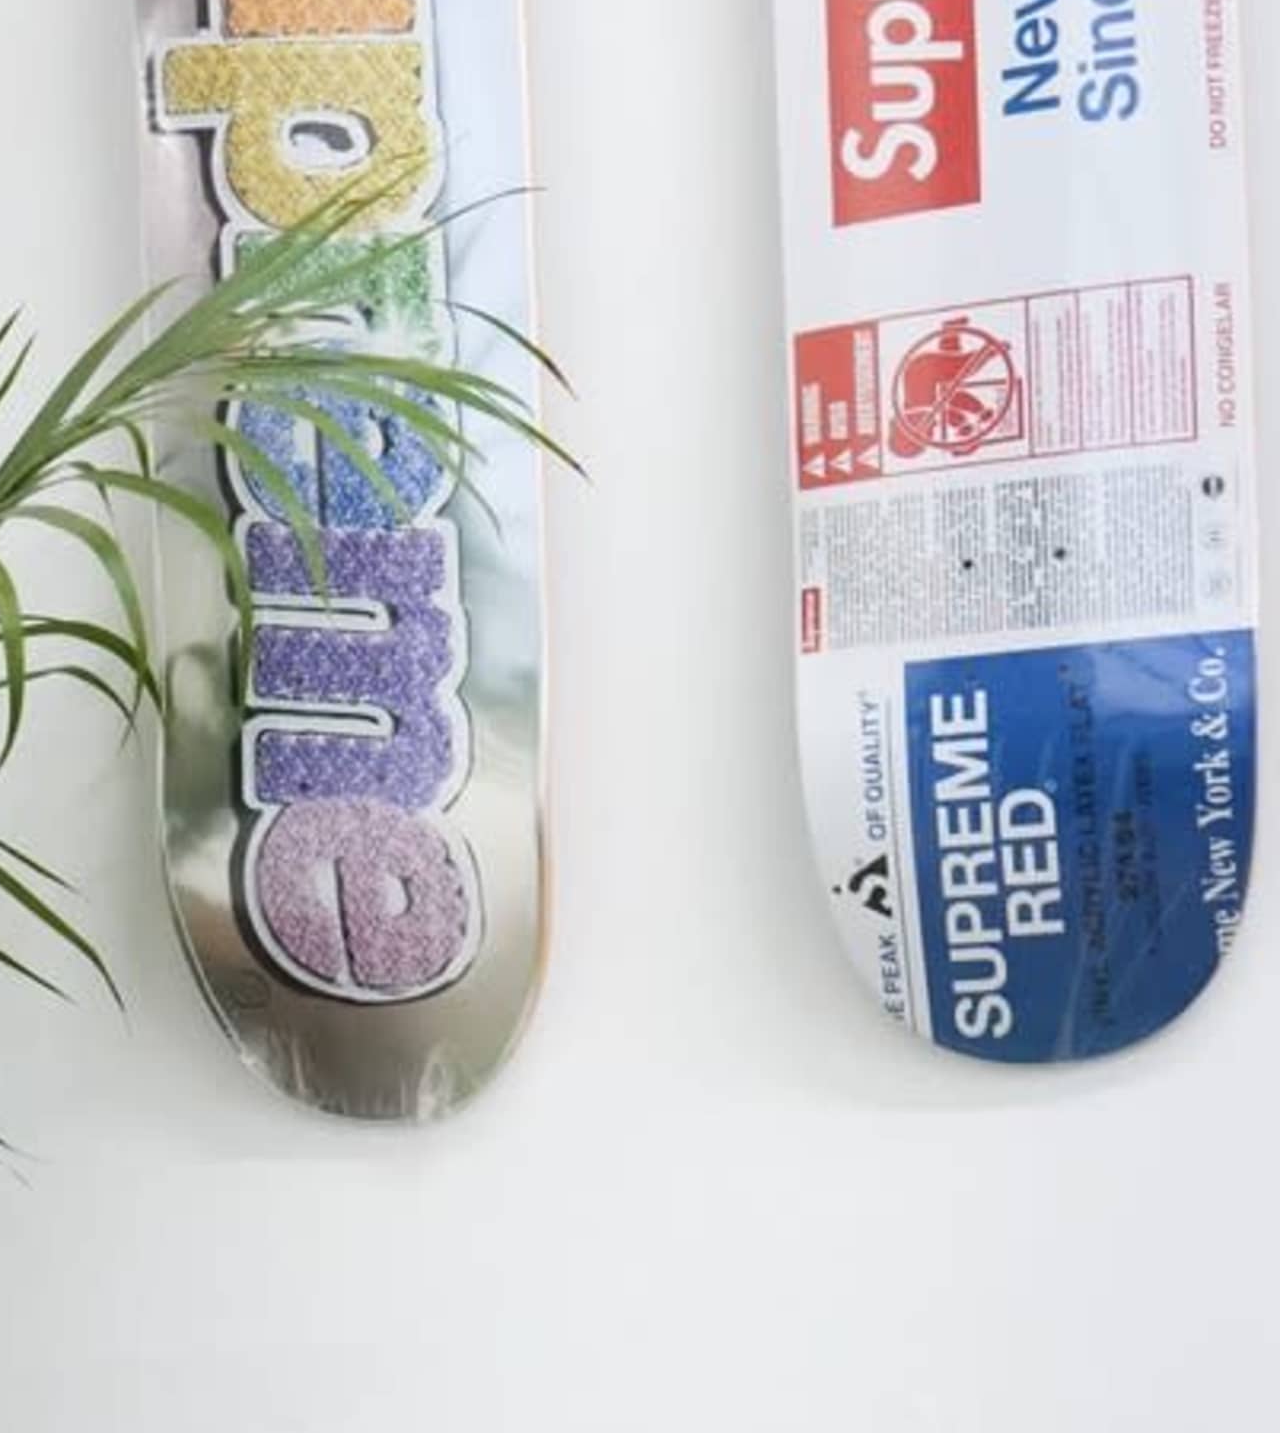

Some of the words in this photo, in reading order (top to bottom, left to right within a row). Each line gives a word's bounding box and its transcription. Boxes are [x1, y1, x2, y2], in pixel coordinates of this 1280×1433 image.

[1206, 76, 1226, 116] NOT
[1207, 120, 1227, 149] DO
[1186, 646, 1230, 705] Co.
[859, 701, 884, 802] QUALITY
[1189, 712, 1229, 742] &
[1193, 748, 1234, 828] York
[864, 807, 886, 841] OF
[930, 689, 1014, 1040] SUPREME
[997, 787, 1067, 938] RED
[1200, 836, 1239, 904] New
[877, 933, 902, 995] PEAK
